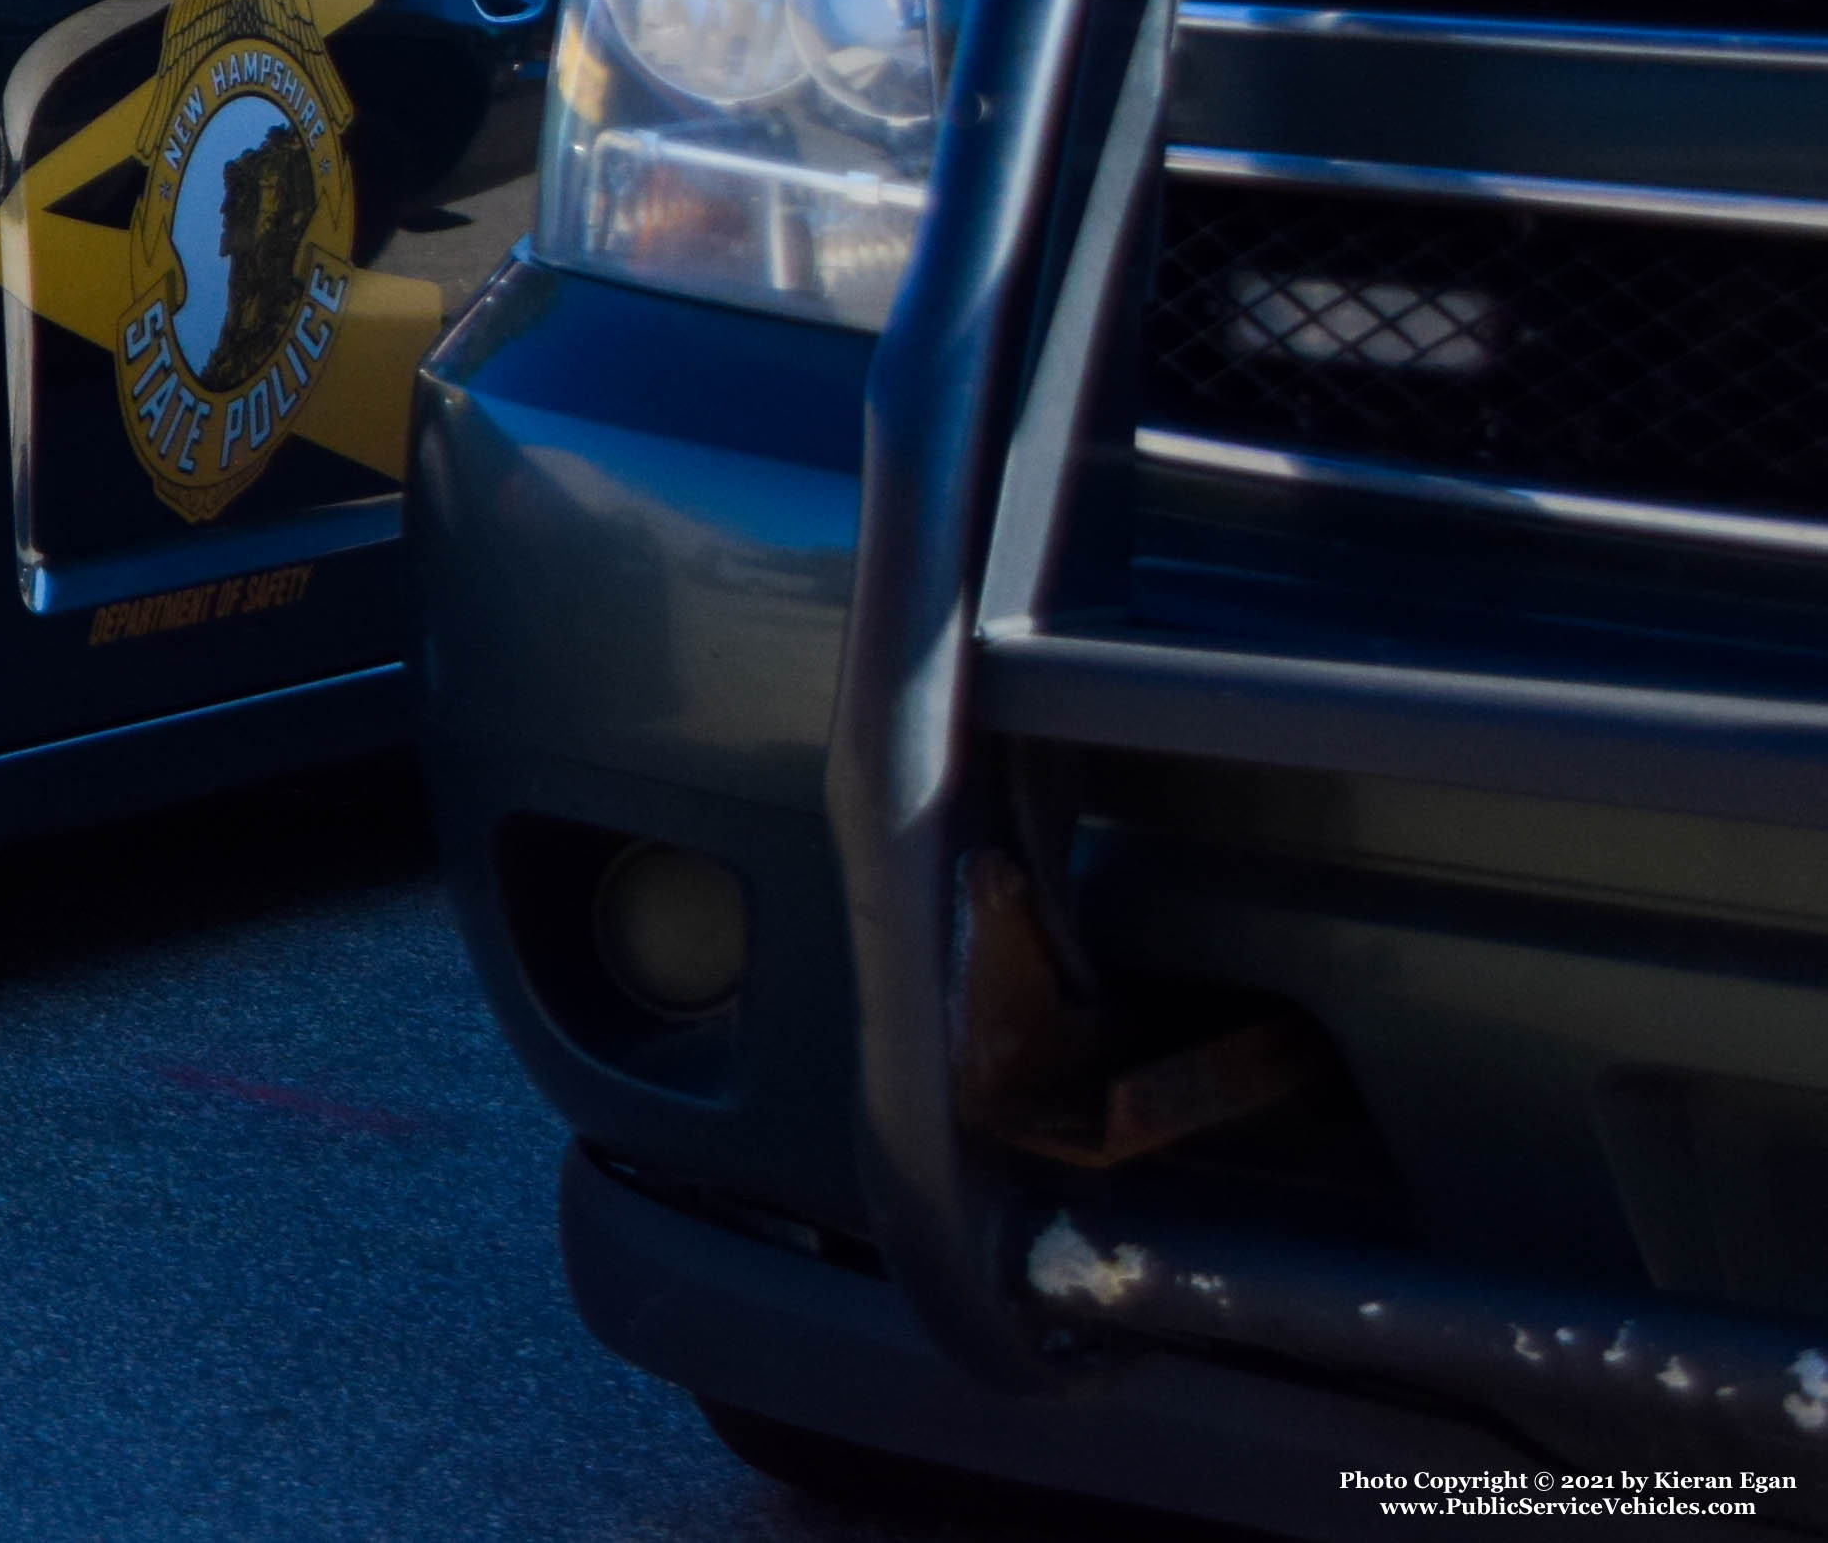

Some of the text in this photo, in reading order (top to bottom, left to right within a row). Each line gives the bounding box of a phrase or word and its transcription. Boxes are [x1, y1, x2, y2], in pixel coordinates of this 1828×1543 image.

[163, 51, 325, 170] NEW HAMPSHIRE
[125, 266, 345, 472] STATE POLICE
